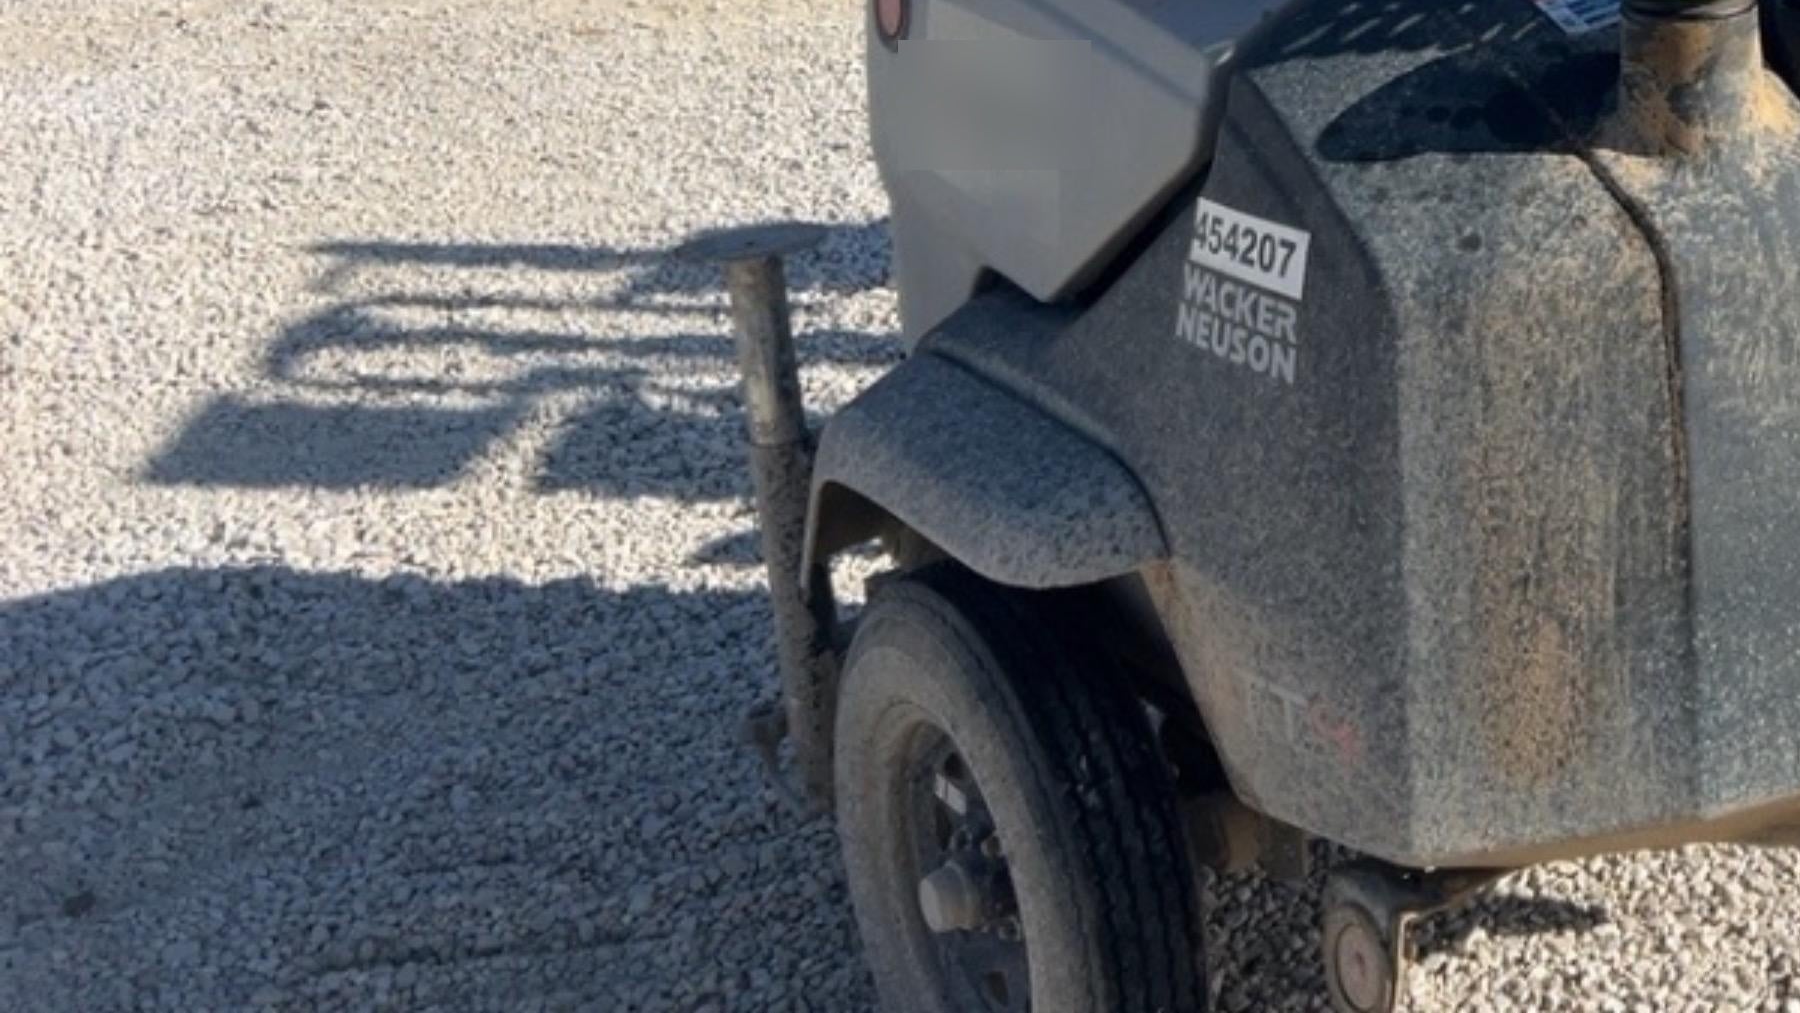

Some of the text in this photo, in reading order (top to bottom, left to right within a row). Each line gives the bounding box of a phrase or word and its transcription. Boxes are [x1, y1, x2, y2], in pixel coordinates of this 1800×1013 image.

[1196, 211, 1297, 278] 454207
[1174, 302, 1297, 385] NEUSON
[1184, 260, 1298, 346] WACKER
